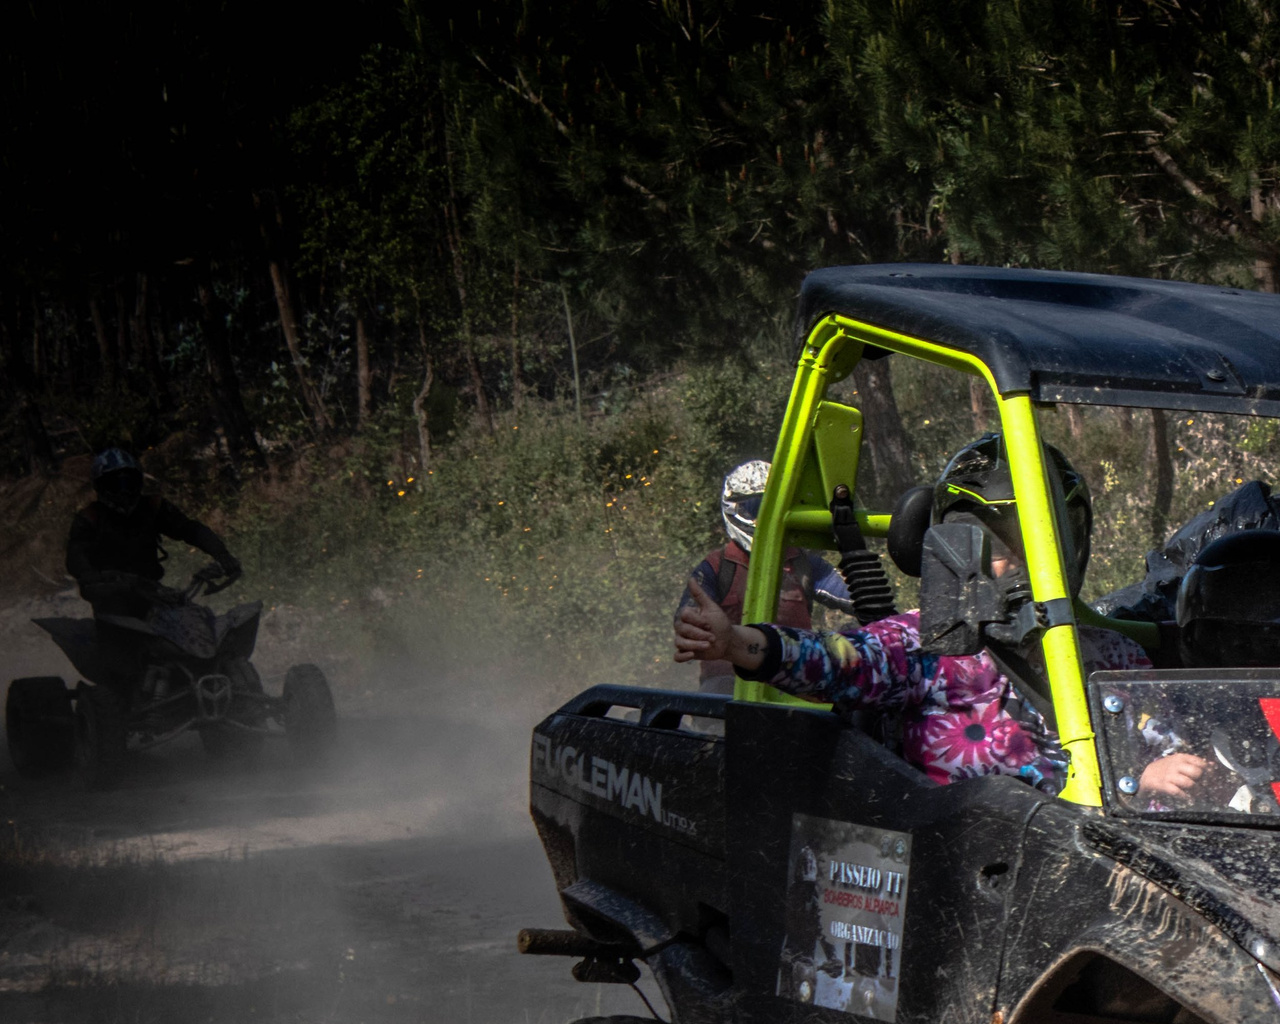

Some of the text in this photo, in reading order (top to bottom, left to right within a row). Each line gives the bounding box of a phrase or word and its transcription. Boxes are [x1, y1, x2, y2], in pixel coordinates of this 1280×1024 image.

[533, 733, 662, 822] FUGLEMAN
[829, 860, 903, 893] PASSEIO TT
